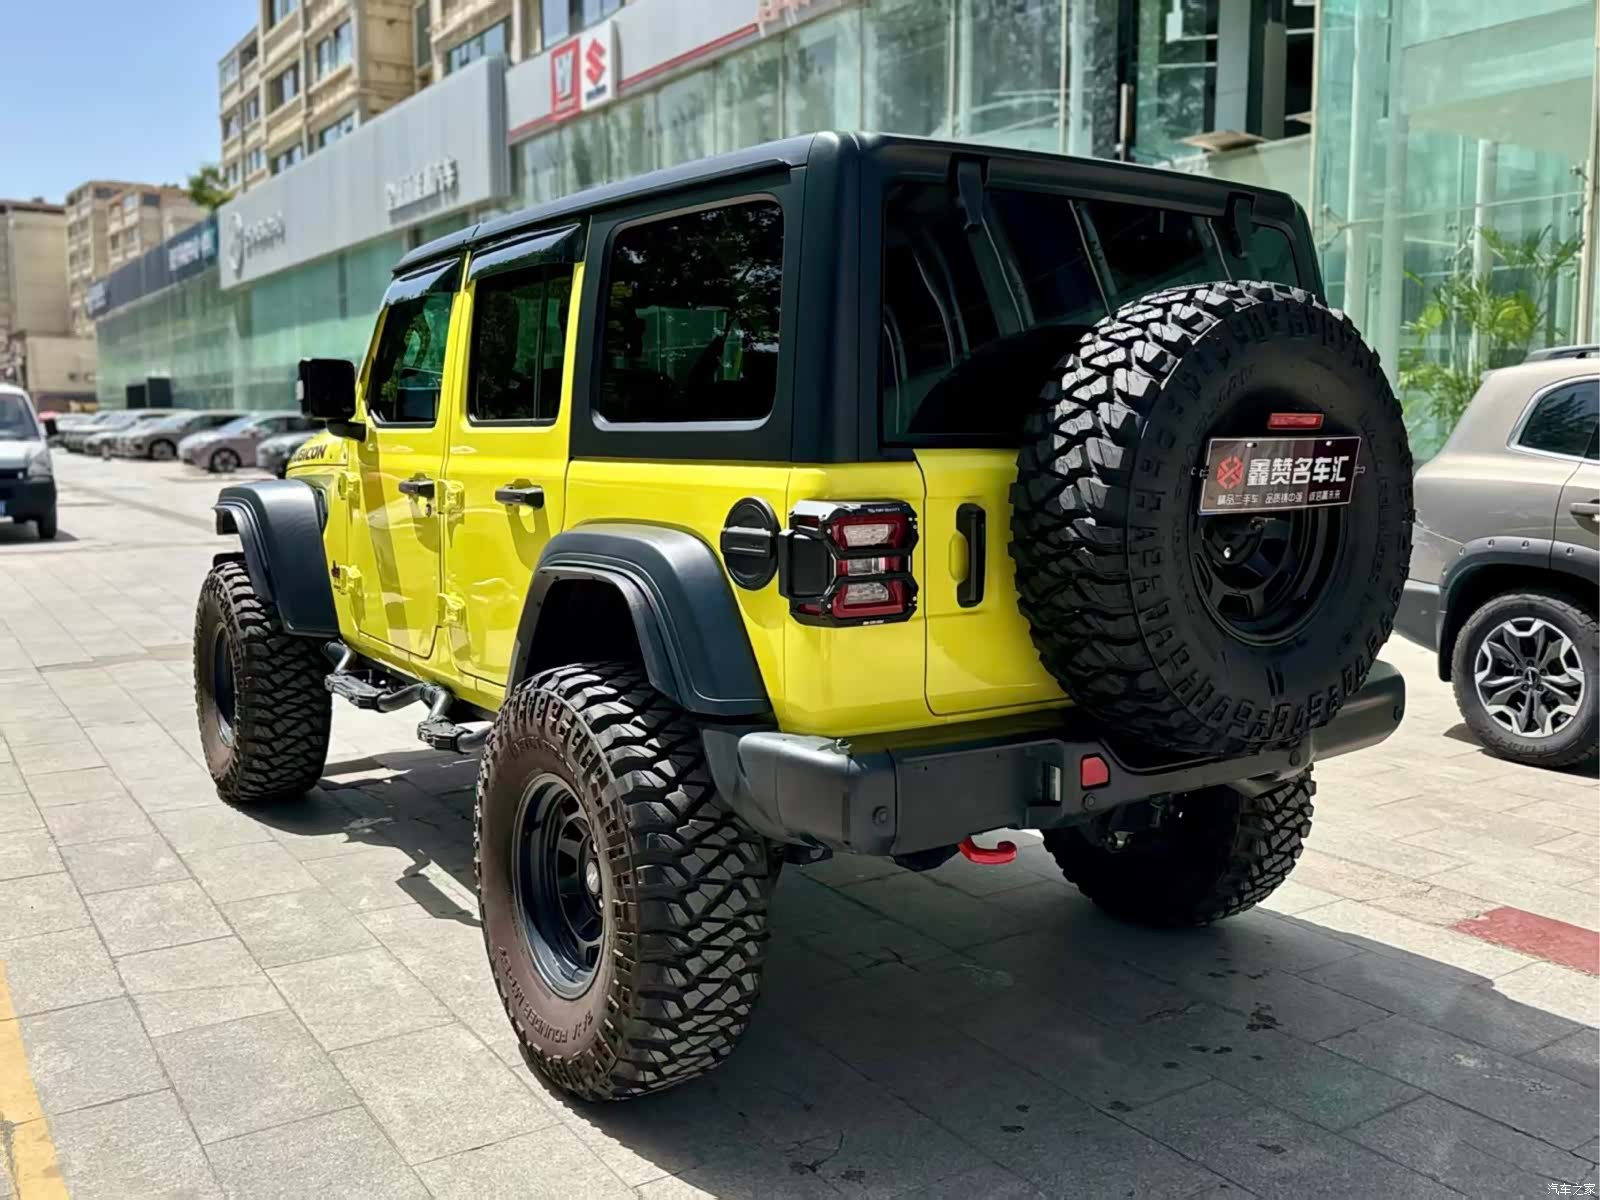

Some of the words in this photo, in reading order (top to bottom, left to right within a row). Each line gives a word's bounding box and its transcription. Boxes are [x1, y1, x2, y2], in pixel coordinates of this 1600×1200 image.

[1247, 455, 1350, 487] 鑫赞名车汇
